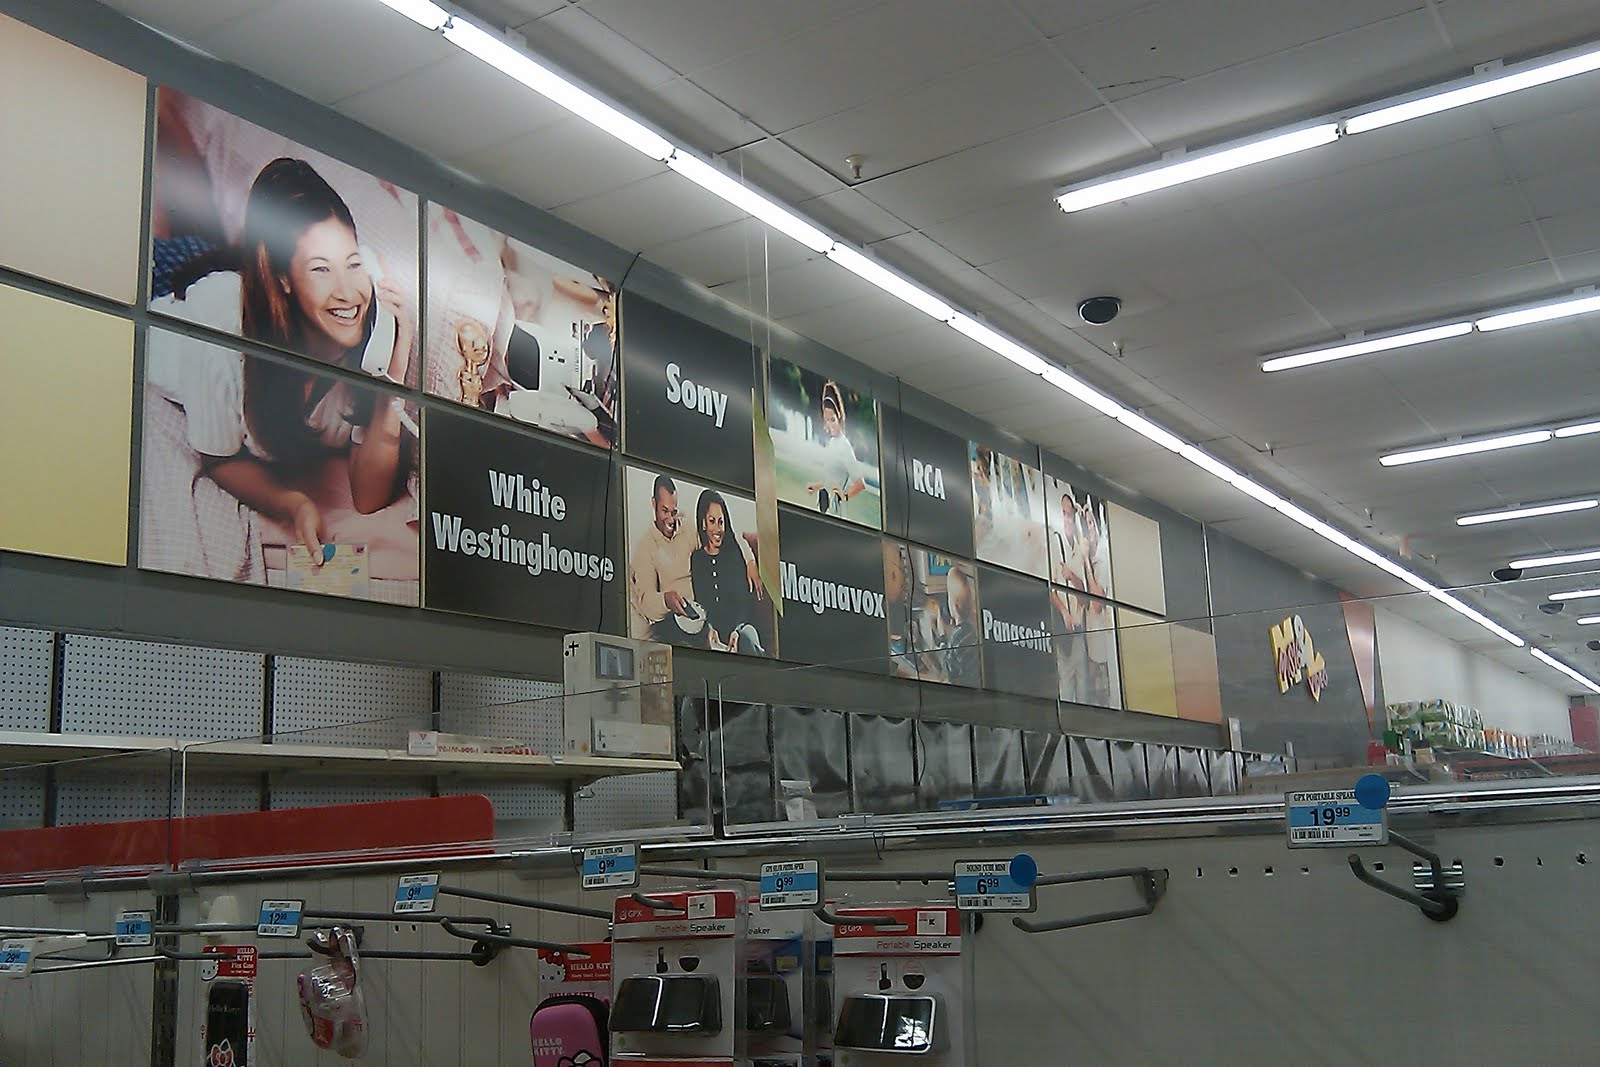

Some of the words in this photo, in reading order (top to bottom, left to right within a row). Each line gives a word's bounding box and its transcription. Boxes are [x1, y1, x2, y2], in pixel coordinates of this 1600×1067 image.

[665, 362, 728, 429] Sony
[488, 469, 567, 522] White
[912, 458, 946, 501] RCA
[430, 511, 615, 583] Westinghouse
[778, 560, 886, 620] Magnavox
[982, 608, 1053, 654] Panasonic
[1306, 791, 1336, 801] PORTABLE
[690, 923, 726, 934] Speaker
[913, 940, 952, 950] Speaker
[570, 962, 594, 970] HELLO
